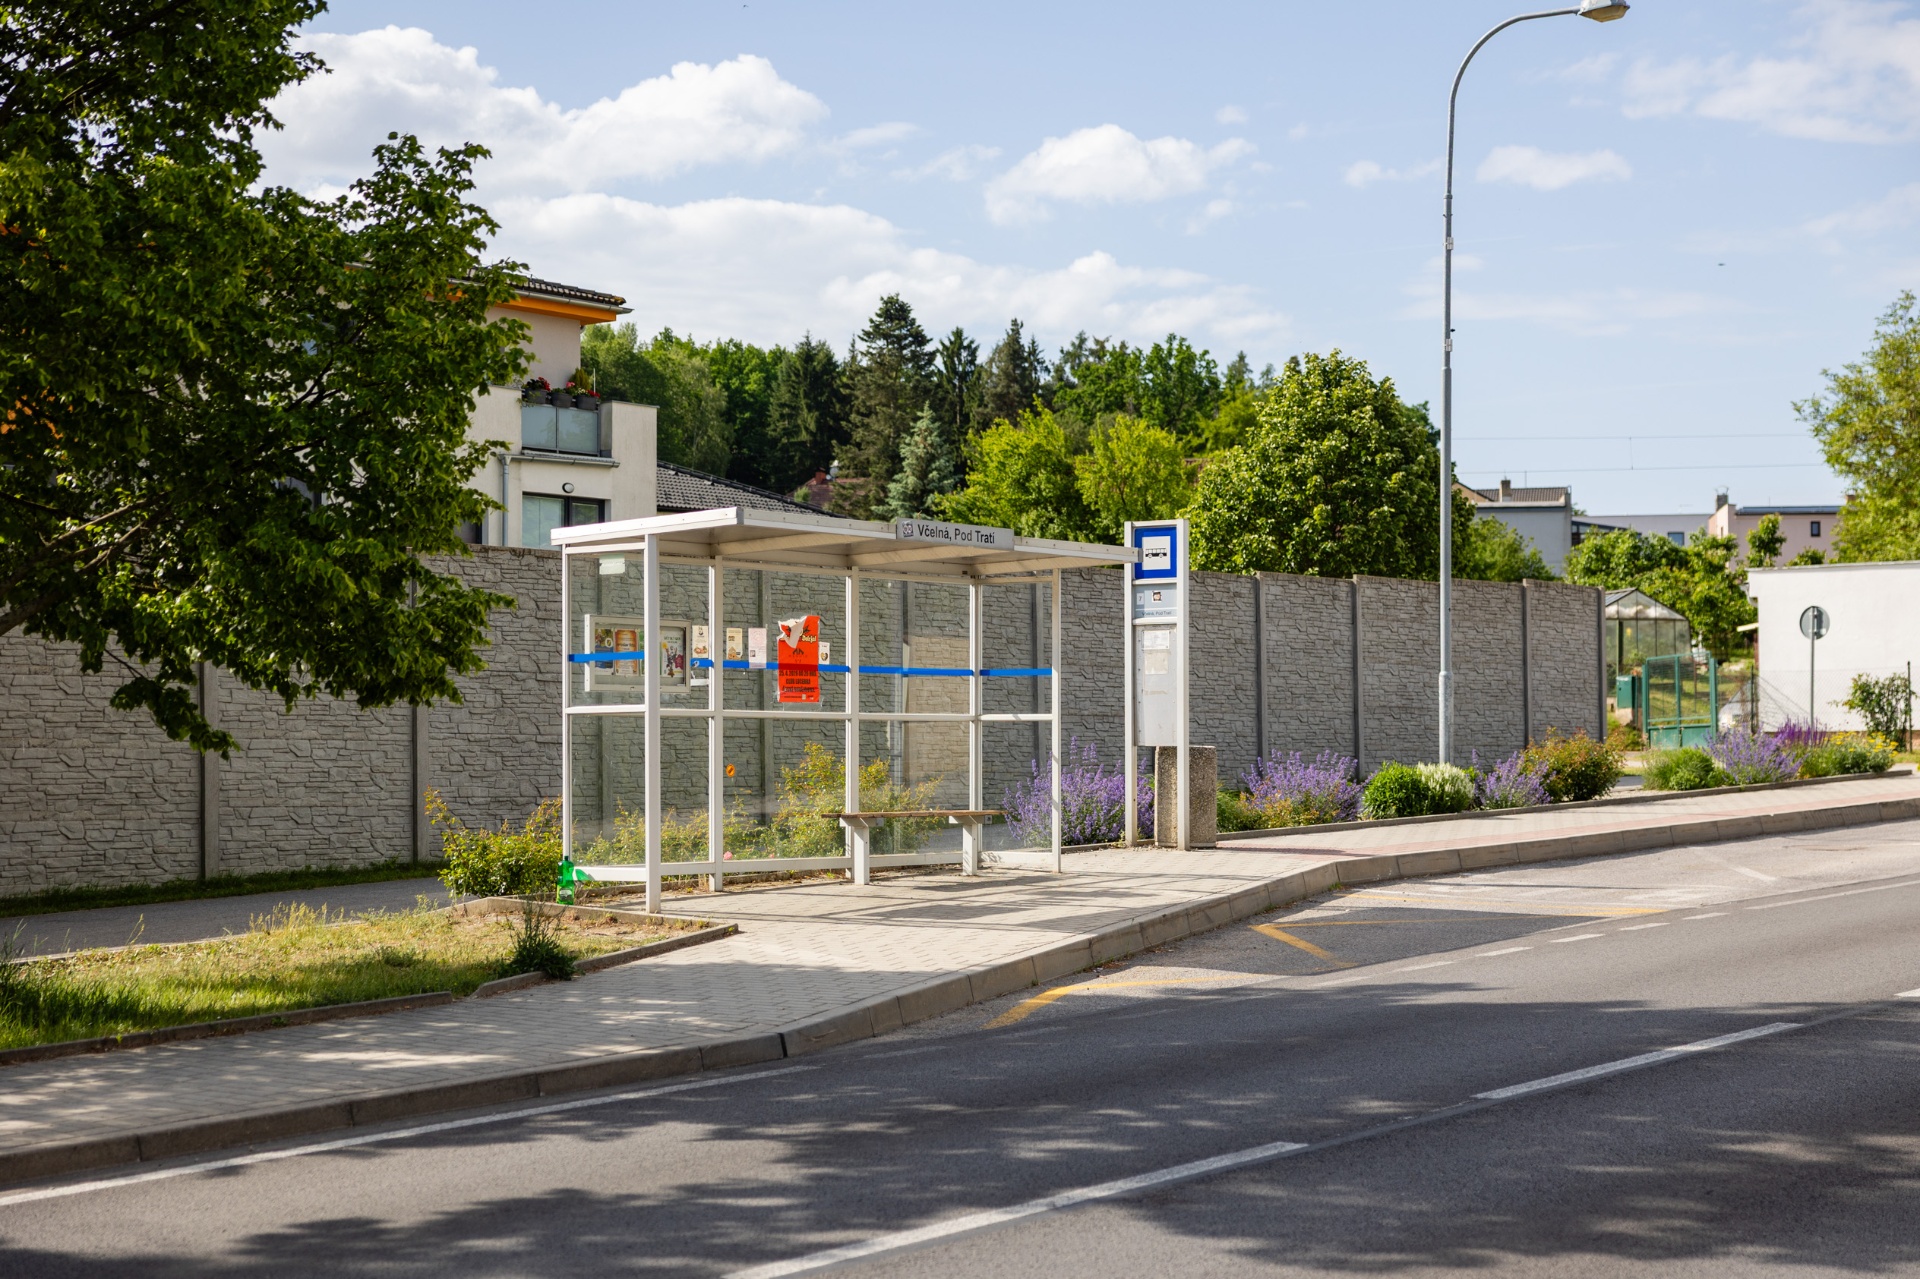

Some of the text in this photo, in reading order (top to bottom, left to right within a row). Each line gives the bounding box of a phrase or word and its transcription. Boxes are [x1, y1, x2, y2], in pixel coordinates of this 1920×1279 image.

[917, 524, 995, 544] Včelná, Pod Tratí
